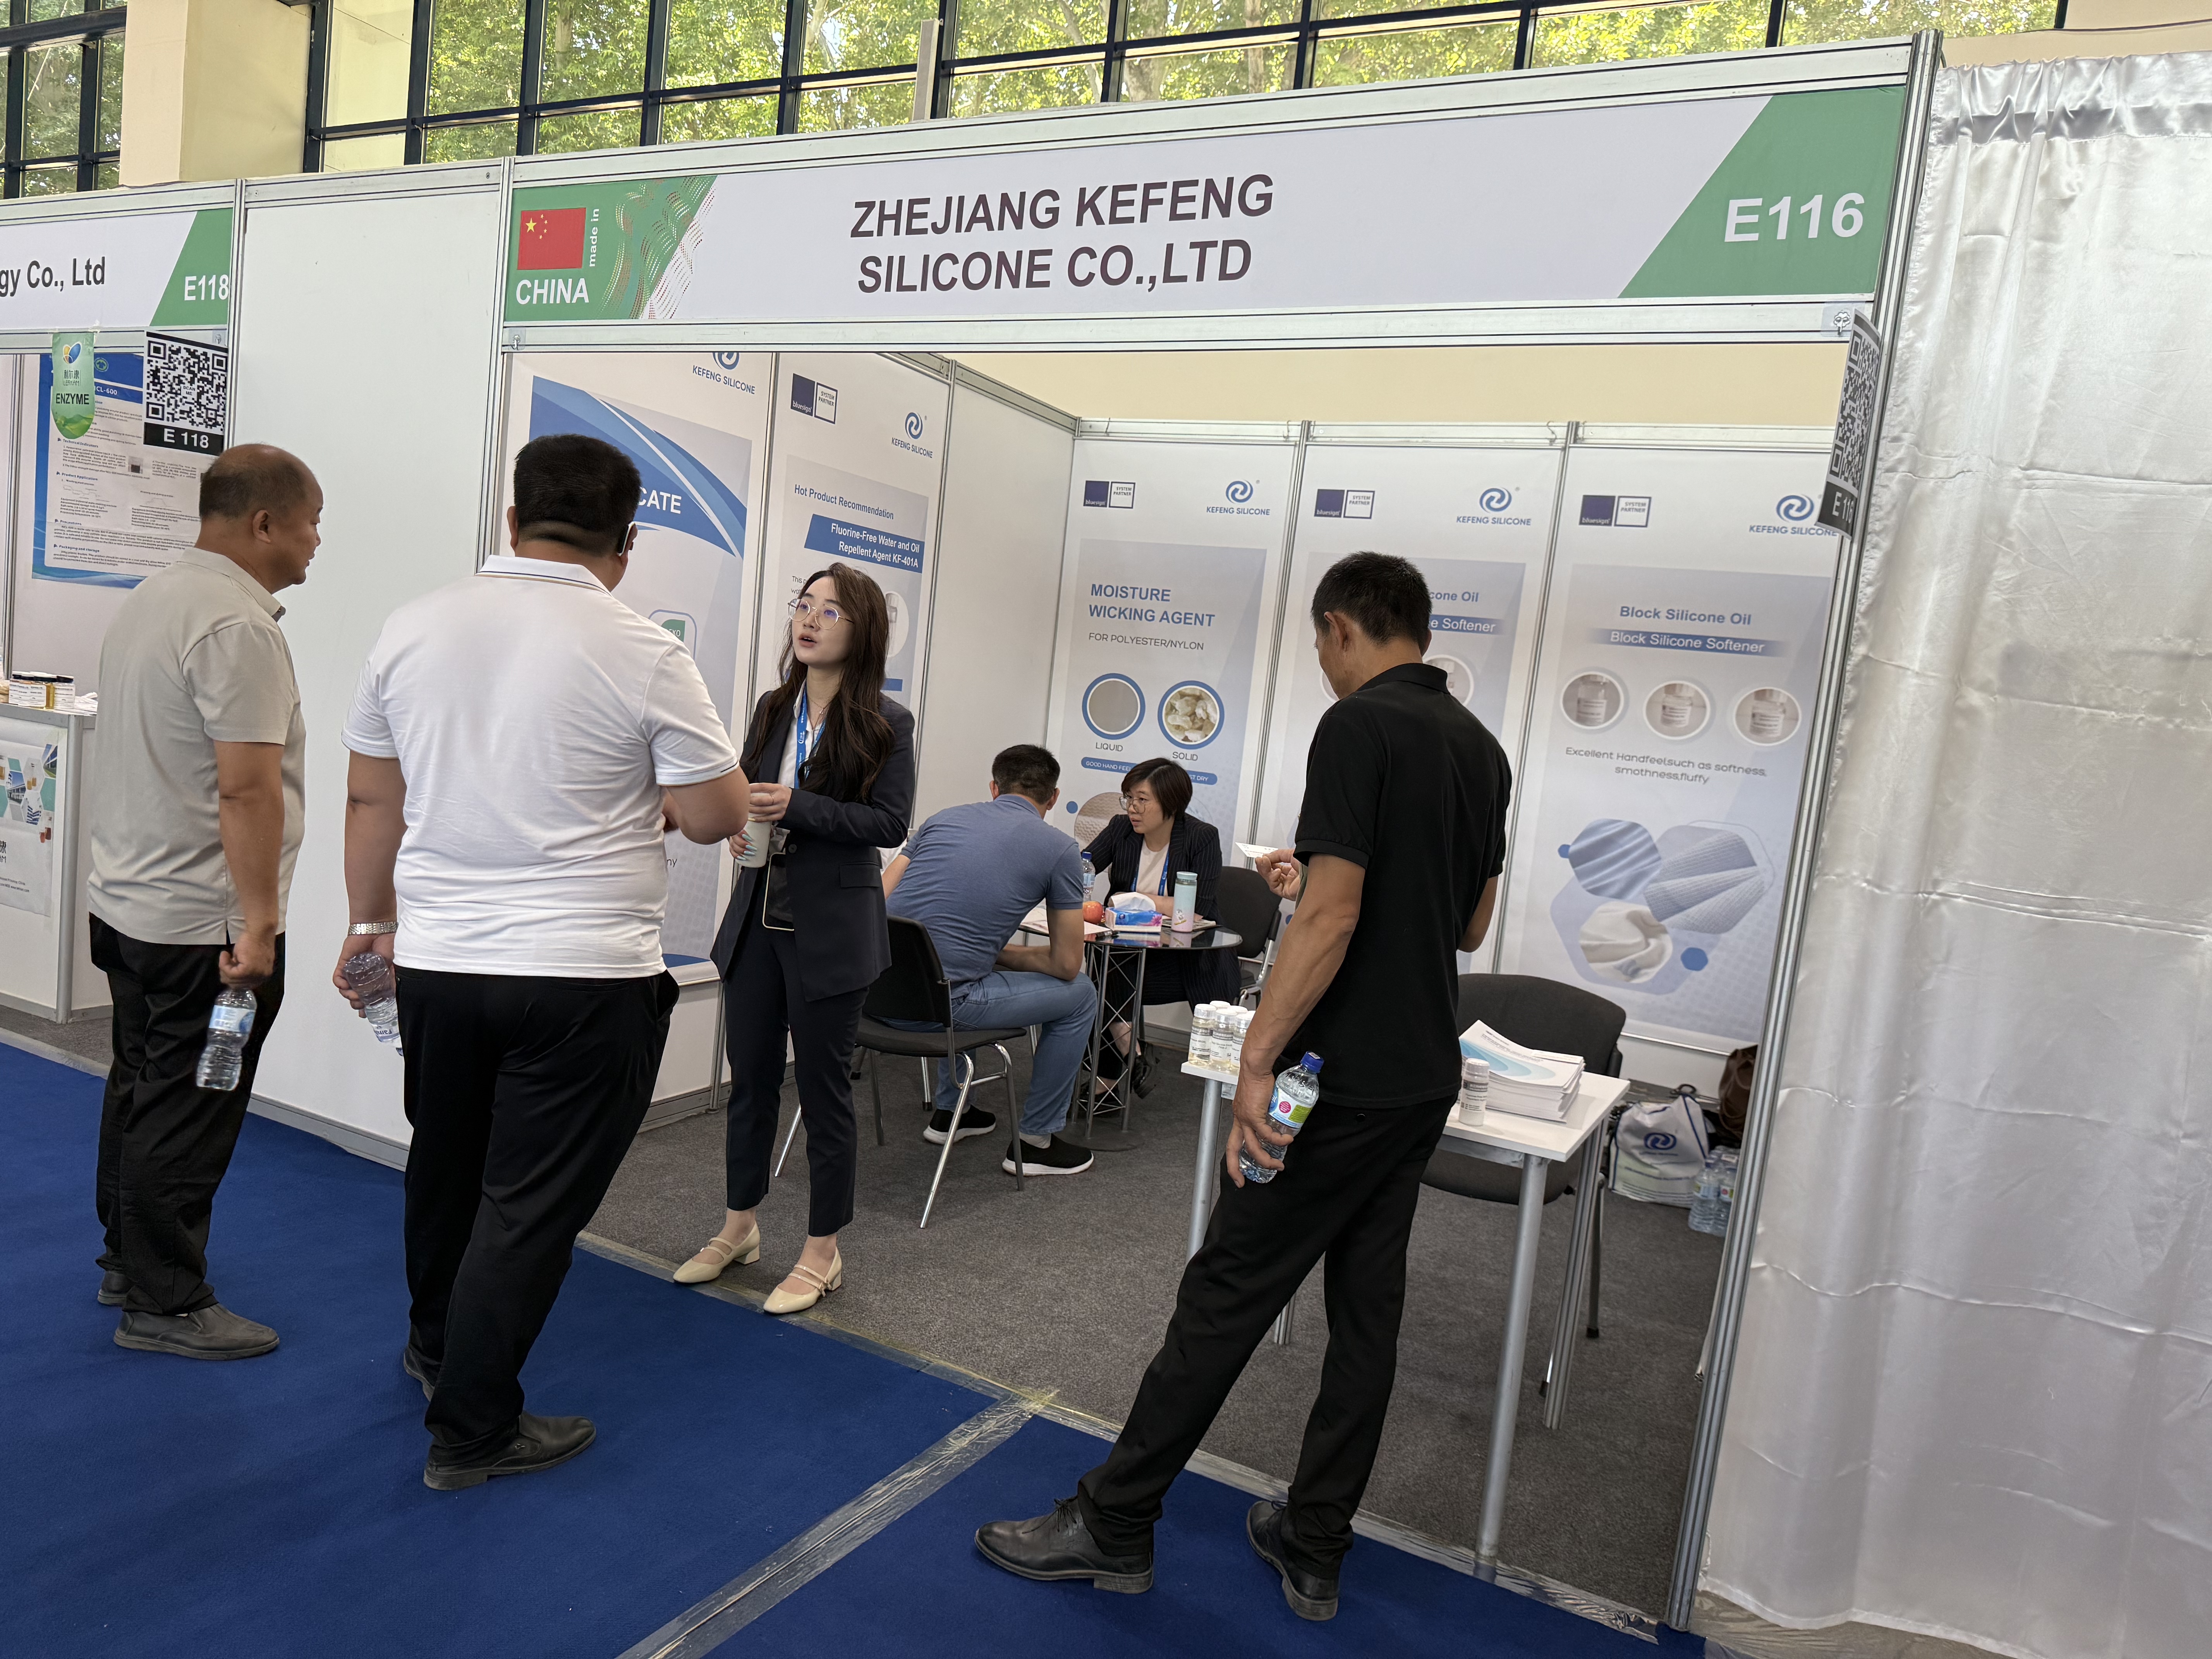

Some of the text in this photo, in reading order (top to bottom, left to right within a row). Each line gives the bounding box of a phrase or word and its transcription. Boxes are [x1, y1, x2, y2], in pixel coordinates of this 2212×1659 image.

[850, 174, 1274, 237] ZHEJIANG KEFENG
[1724, 192, 1865, 242] E116
[589, 208, 600, 267] made in
[27, 260, 64, 292] Co.,
[72, 256, 105, 285] Ltd
[858, 239, 1252, 293] SILICONE CO.,LTD
[184, 274, 229, 301] E118
[516, 278, 589, 305] CHINA
[94, 386, 117, 395] CL-600
[692, 365, 756, 395] KEFENG SILICONE
[56, 393, 89, 405] ENZYME
[818, 397, 834, 406] PARTNER
[821, 391, 835, 400] SYSTEM
[164, 428, 209, 449] E 118
[891, 437, 933, 459] KEFENG SILICONE
[794, 484, 894, 520] Hot Product Recommendation
[1206, 506, 1271, 516] KEFENG SILICONE
[1832, 491, 1854, 524] E 116
[1456, 516, 1532, 526] KEFENG SILICONE
[1749, 525, 1788, 534] KEFENG
[831, 523, 920, 553] Fluorine-Free Water and Oil
[839, 541, 919, 568] Repellent Agent KF-401A
[1091, 584, 1171, 602] MOISTURE
[1462, 591, 1479, 602] Oil
[1089, 605, 1216, 627] WICKING AGENT
[1442, 618, 1496, 632] Softener
[1620, 606, 1752, 626] Block Silicone Oil
[1089, 632, 1204, 651] FOR POLYESTER/NYLON
[1611, 631, 1765, 653] Block Silicone Softener
[1096, 742, 1123, 752] LIQUID
[1172, 752, 1199, 761] SOLID
[1566, 747, 1614, 759] Excellent
